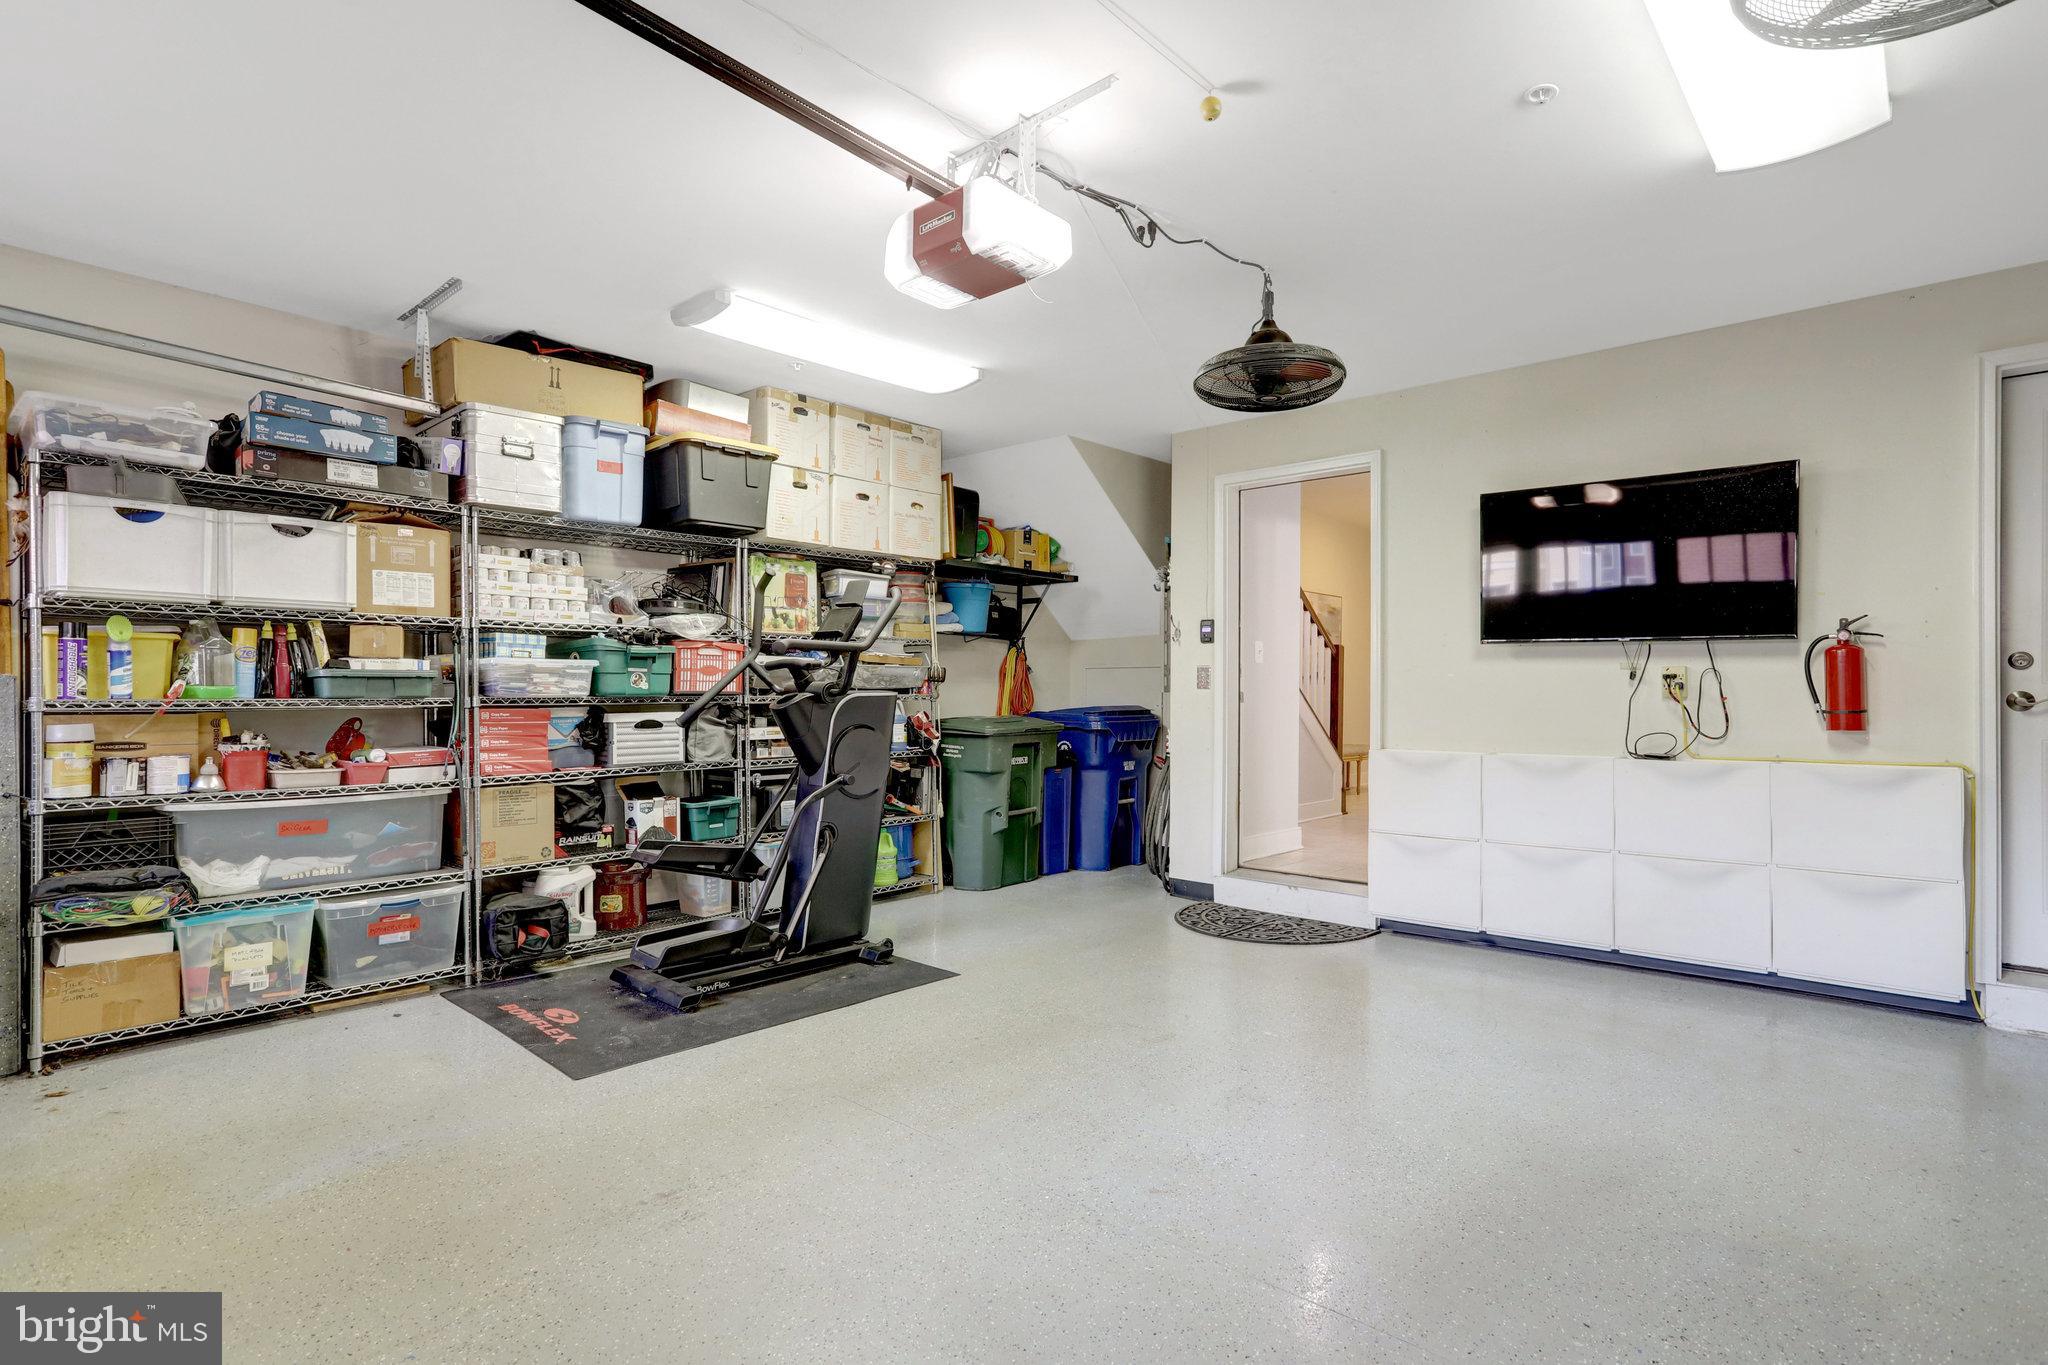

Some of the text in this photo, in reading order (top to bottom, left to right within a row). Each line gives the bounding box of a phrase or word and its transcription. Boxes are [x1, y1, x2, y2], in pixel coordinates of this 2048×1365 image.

[922, 214, 953, 232] LiftMaster
[284, 403, 299, 411] choose
[559, 832, 599, 845] RAINSUIT
[497, 1003, 577, 1045] BOWFLEX
